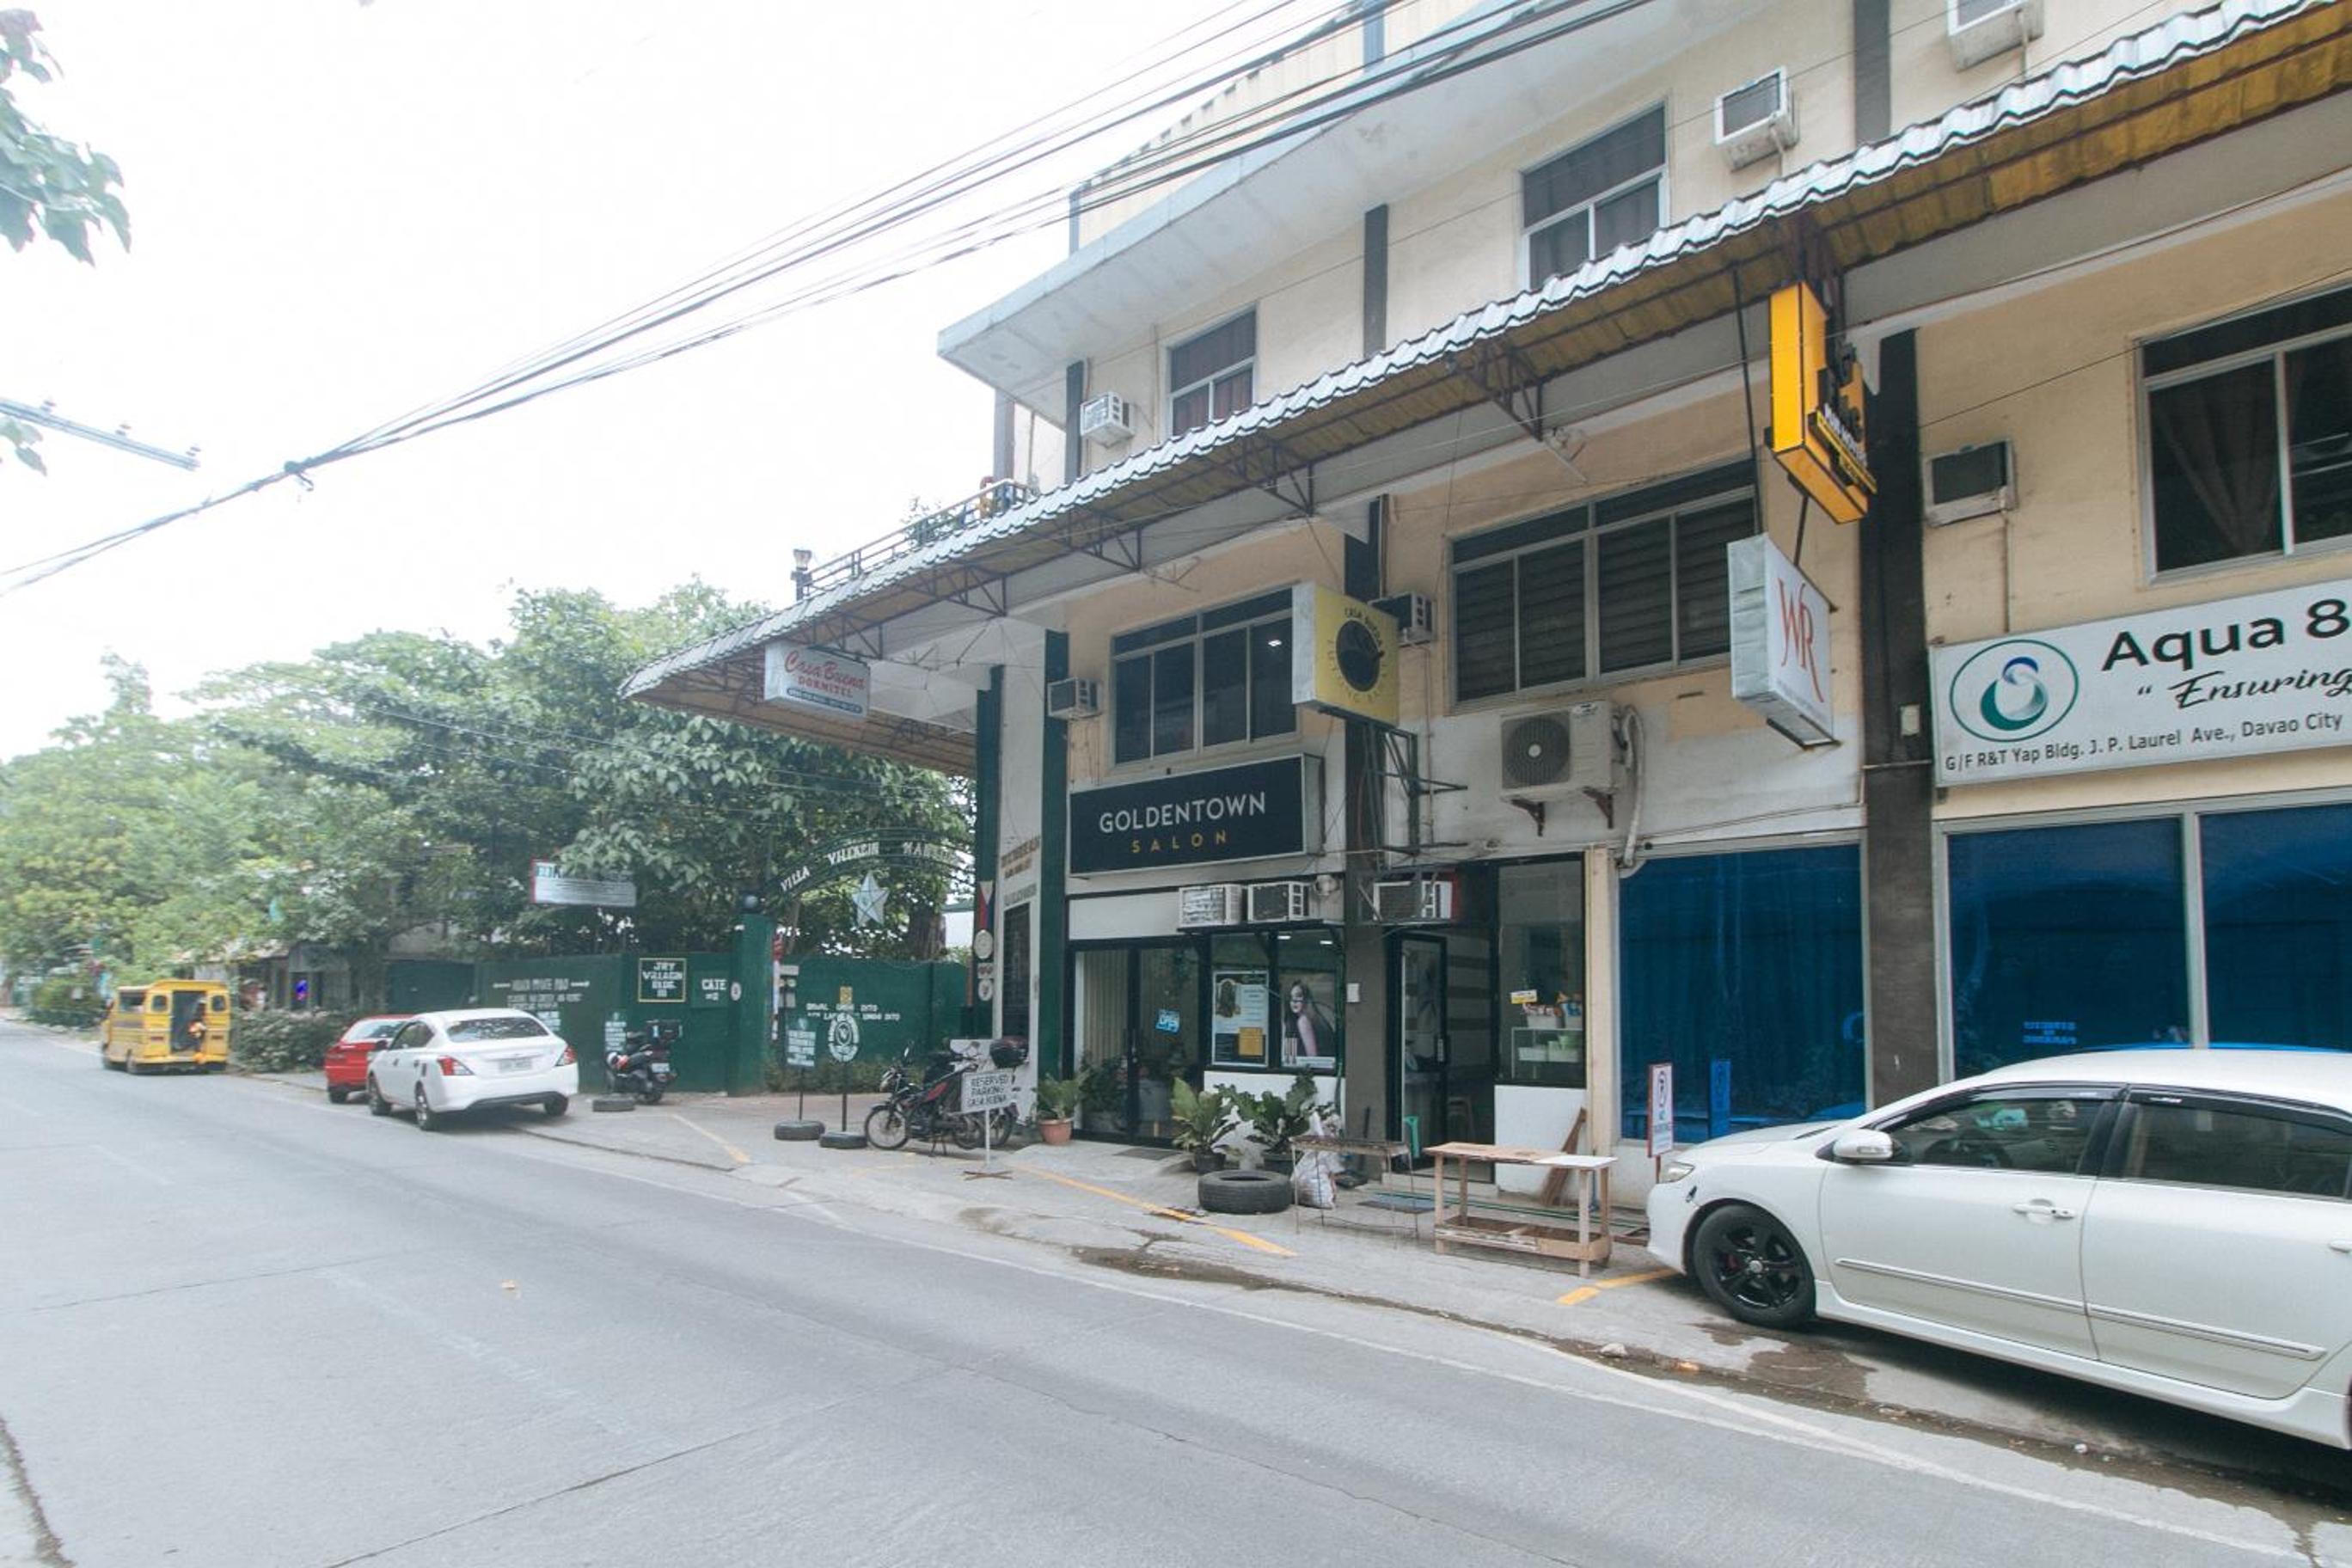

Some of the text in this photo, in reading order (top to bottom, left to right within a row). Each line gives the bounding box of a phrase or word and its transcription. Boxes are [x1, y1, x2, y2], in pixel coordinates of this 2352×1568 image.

[2101, 598, 2351, 671] Aqua 8
[784, 650, 820, 677] Casa
[1978, 750, 2007, 767] R&T
[2012, 748, 2041, 764] Yap
[2045, 743, 2085, 760] Bldg.
[2089, 739, 2104, 755] J.
[2108, 738, 2123, 752] P.
[2128, 729, 2182, 750] Laurel
[2241, 719, 2300, 738] Davao
[2306, 712, 2343, 732] City
[1099, 792, 1266, 834] GOLDENTOWN
[1130, 830, 1227, 854] SALON
[780, 866, 811, 891] VILLA
